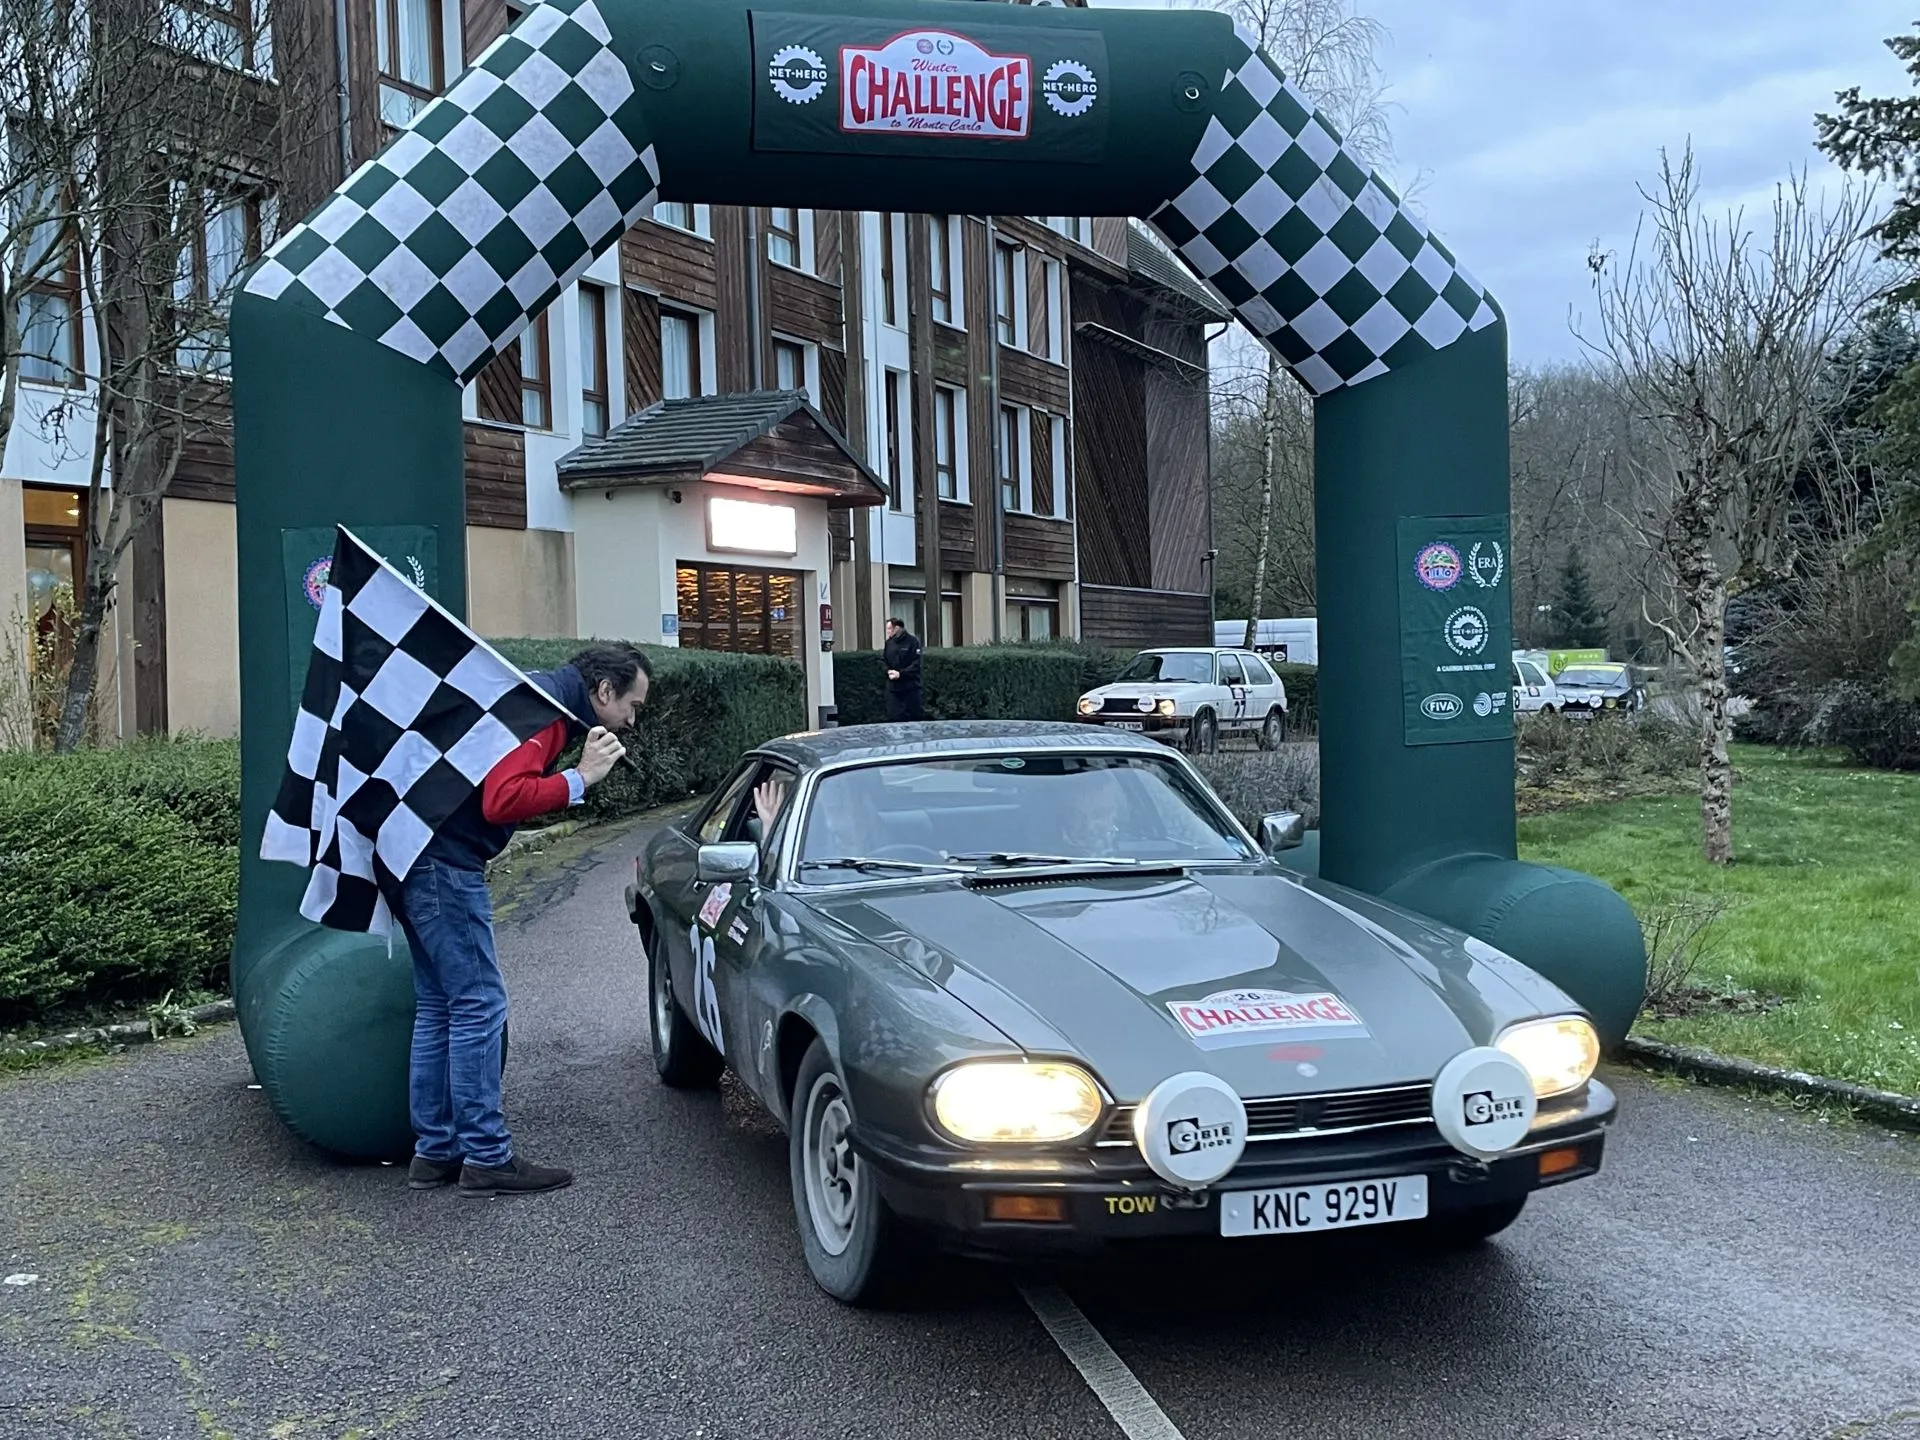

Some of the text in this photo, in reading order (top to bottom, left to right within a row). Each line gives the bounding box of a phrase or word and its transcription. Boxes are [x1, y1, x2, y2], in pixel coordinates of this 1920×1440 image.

[911, 58, 958, 73] Winter
[769, 67, 828, 80] NET-HERO
[850, 54, 1022, 132] CHALLENGE
[1042, 81, 1097, 94] NET-HERO
[890, 119, 901, 128] to
[1478, 557, 1497, 569] ERA
[825, 608, 832, 620] H
[1429, 700, 1455, 713] FIVA
[1178, 997, 1352, 1032] CHALLENGE
[1476, 1099, 1523, 1115] CIBIE
[1181, 1125, 1230, 1143] CIBIE
[1104, 1196, 1157, 1214] TOW
[1253, 1181, 1398, 1230] KNC 929V
